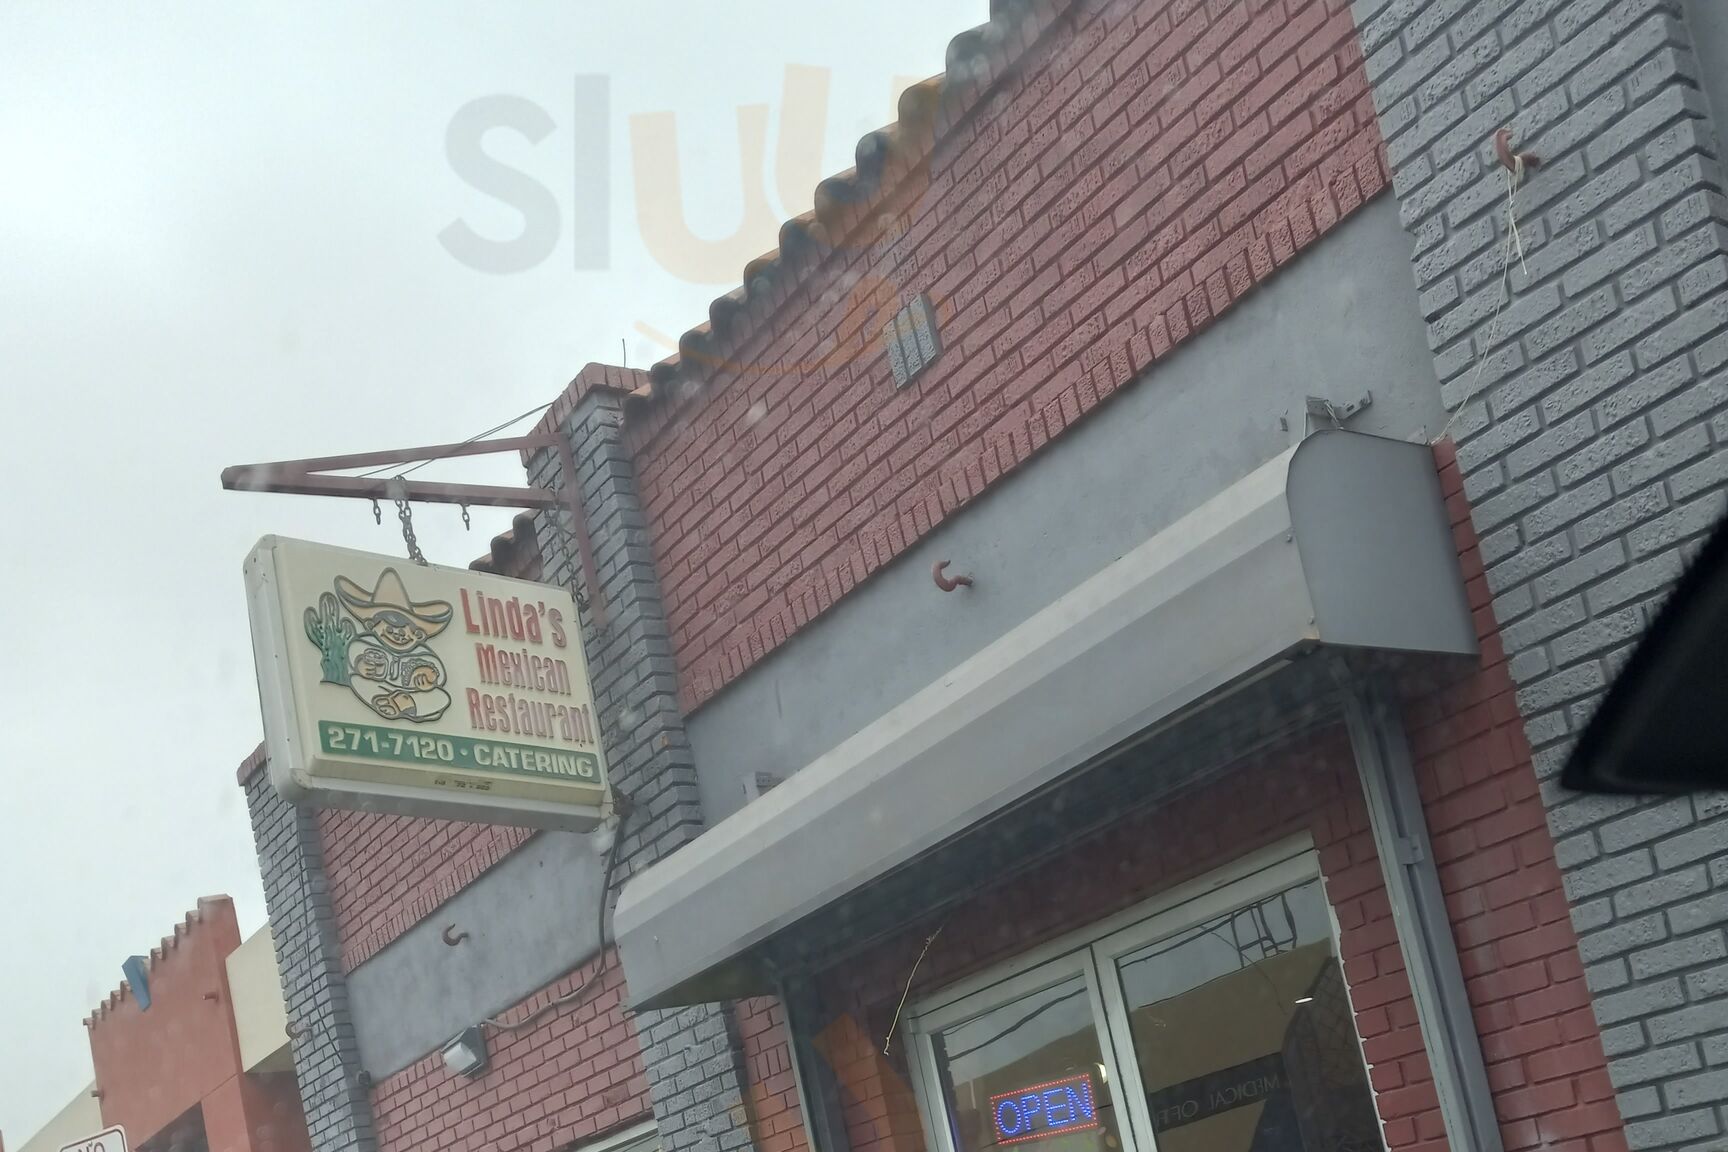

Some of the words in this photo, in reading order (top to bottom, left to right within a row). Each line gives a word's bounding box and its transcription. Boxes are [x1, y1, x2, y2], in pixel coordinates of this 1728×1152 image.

[460, 588, 567, 648] Linda's
[474, 642, 572, 696] Mexican
[466, 687, 595, 745] Restaurant
[327, 725, 455, 762] 271-7120
[473, 742, 594, 779] CATERING
[997, 1081, 1092, 1136] OPEN
